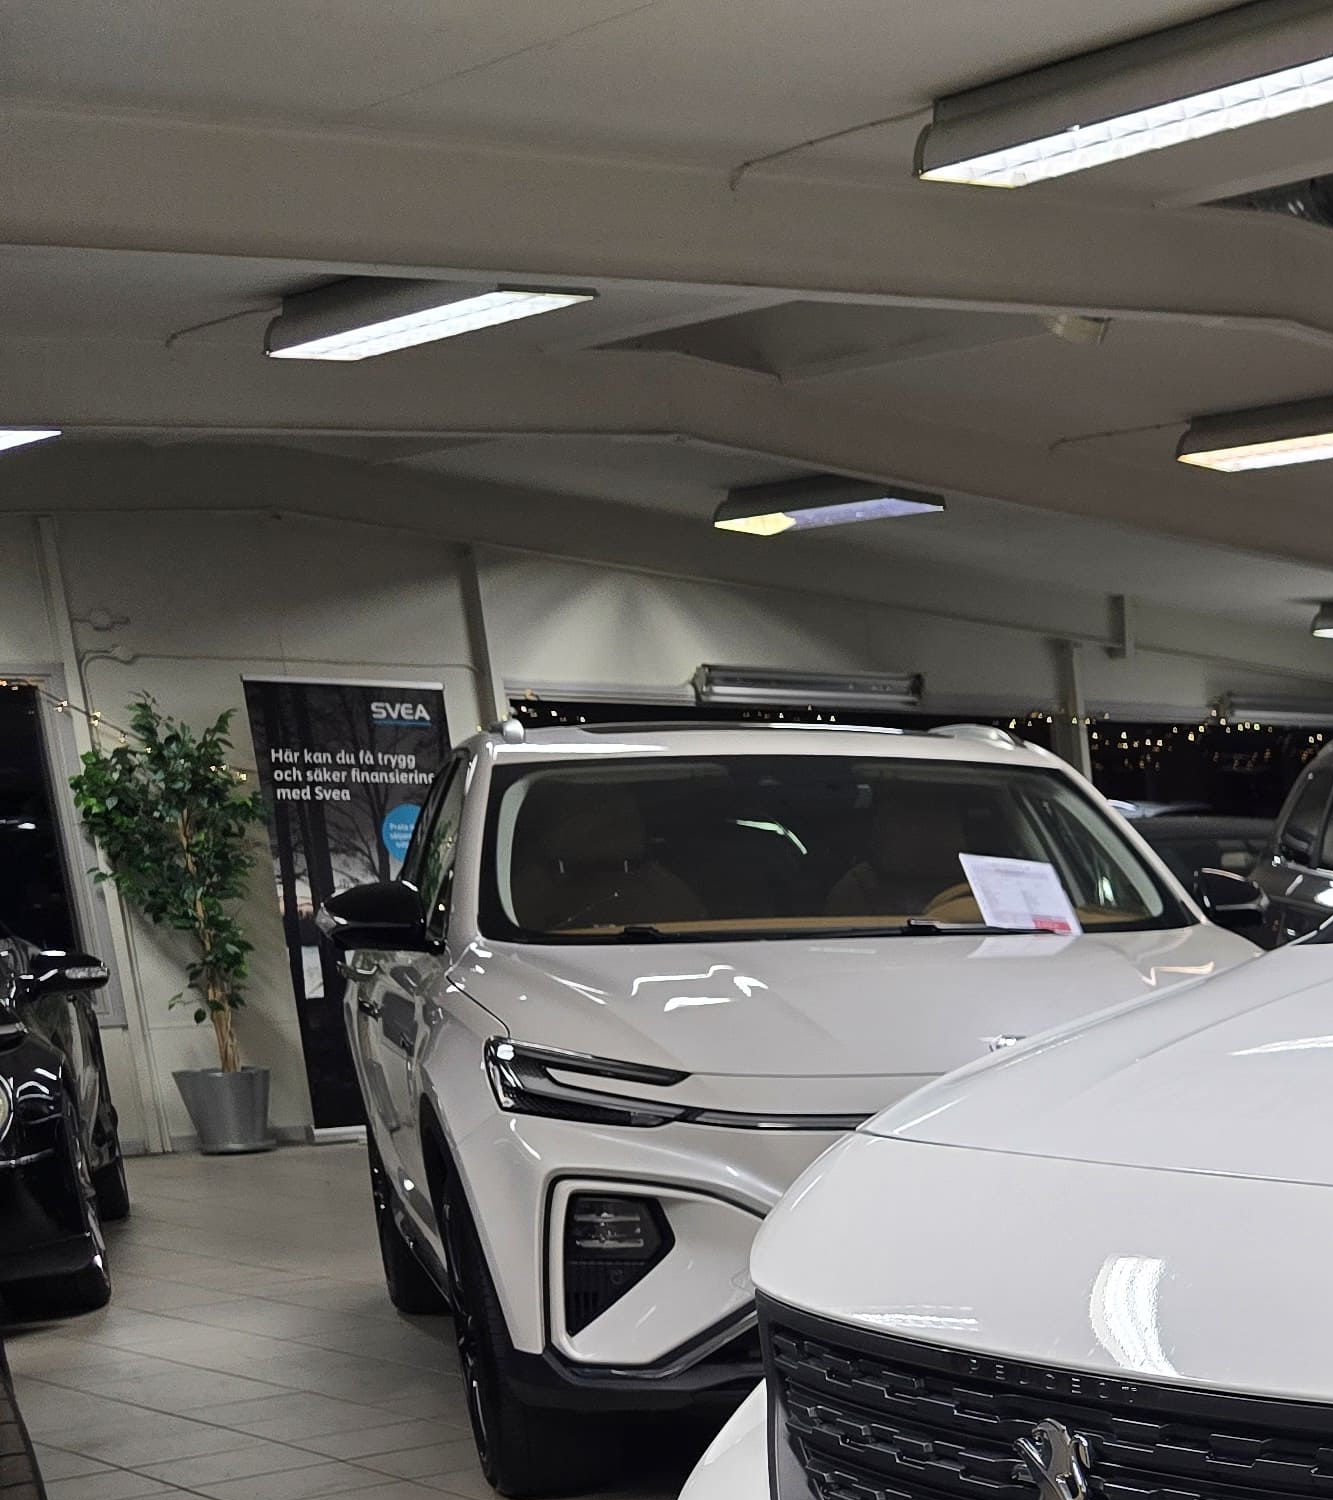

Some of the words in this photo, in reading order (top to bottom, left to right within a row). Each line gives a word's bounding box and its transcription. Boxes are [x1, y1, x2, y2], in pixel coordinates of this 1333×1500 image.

[371, 702, 431, 721] SVEA
[271, 748, 300, 764] Här
[304, 749, 332, 765] kan
[336, 749, 356, 766] du
[359, 749, 375, 766] få
[378, 751, 416, 770] trygg
[273, 766, 303, 782] och
[306, 767, 348, 783] säker
[276, 785, 312, 801] med
[314, 785, 351, 801] Svea
[968, 1358, 1138, 1404] PEUGEOT
